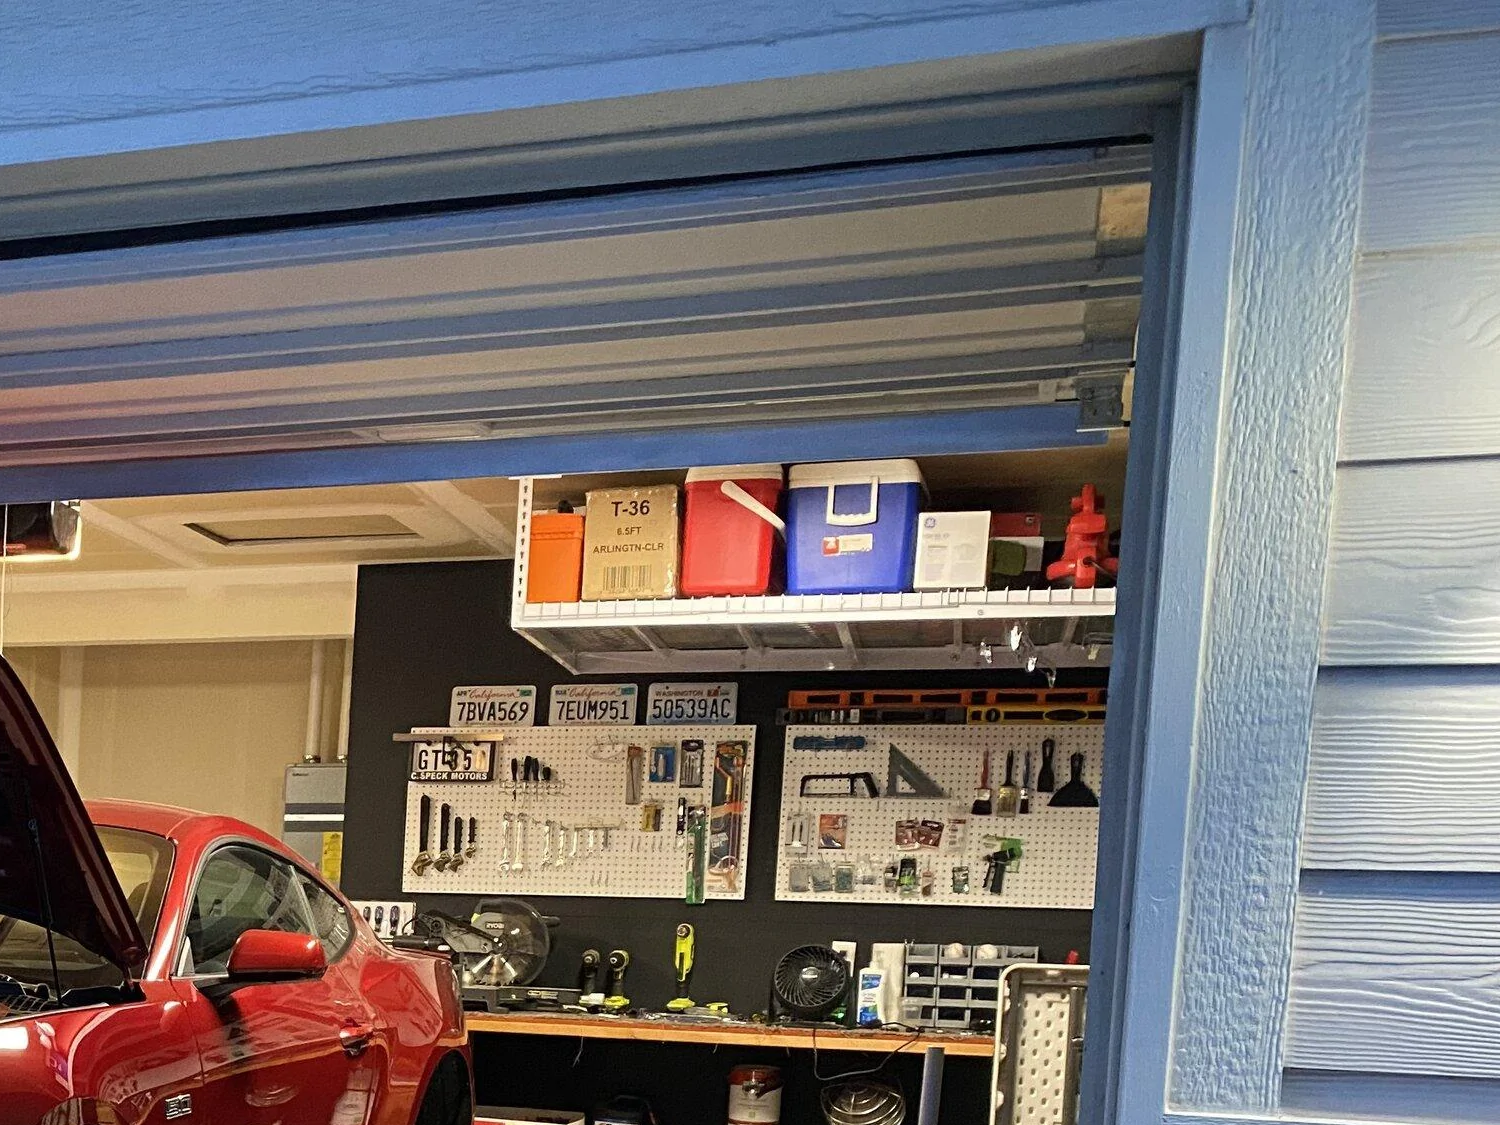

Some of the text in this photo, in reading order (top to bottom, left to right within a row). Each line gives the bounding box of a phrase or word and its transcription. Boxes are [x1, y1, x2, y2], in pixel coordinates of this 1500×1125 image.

[611, 500, 650, 517] T-36
[593, 543, 664, 554] ARLINGTN-CLR
[469, 688, 520, 701] California
[569, 687, 621, 700] California
[655, 689, 704, 697] WASHINGTON
[457, 701, 529, 722] 7BVA569
[556, 700, 630, 720] 7EUM951
[420, 772, 448, 780] SPECK
[450, 772, 488, 780] MOTORS
